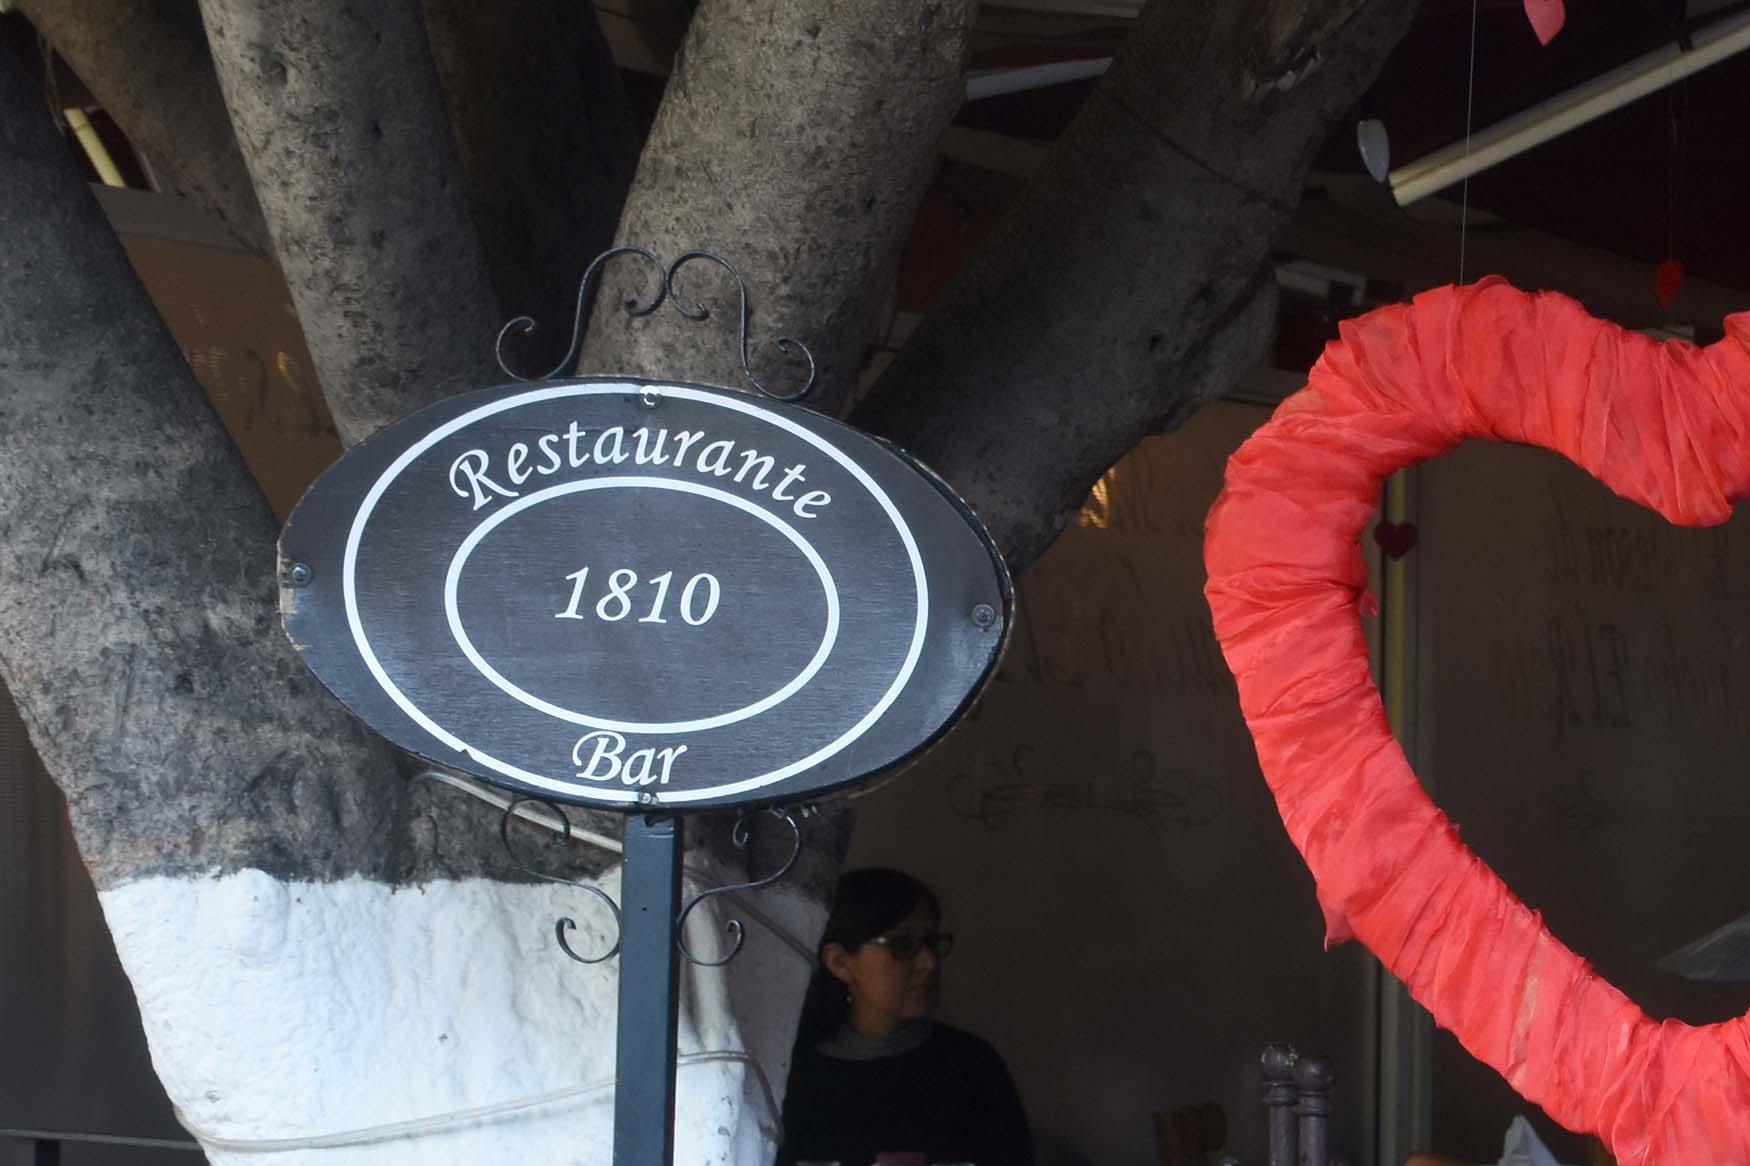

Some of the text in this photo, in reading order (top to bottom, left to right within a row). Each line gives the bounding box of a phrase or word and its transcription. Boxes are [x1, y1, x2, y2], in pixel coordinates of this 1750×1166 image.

[449, 420, 832, 519] Restaurante
[554, 566, 721, 626] 1810
[572, 731, 688, 786] Bar
